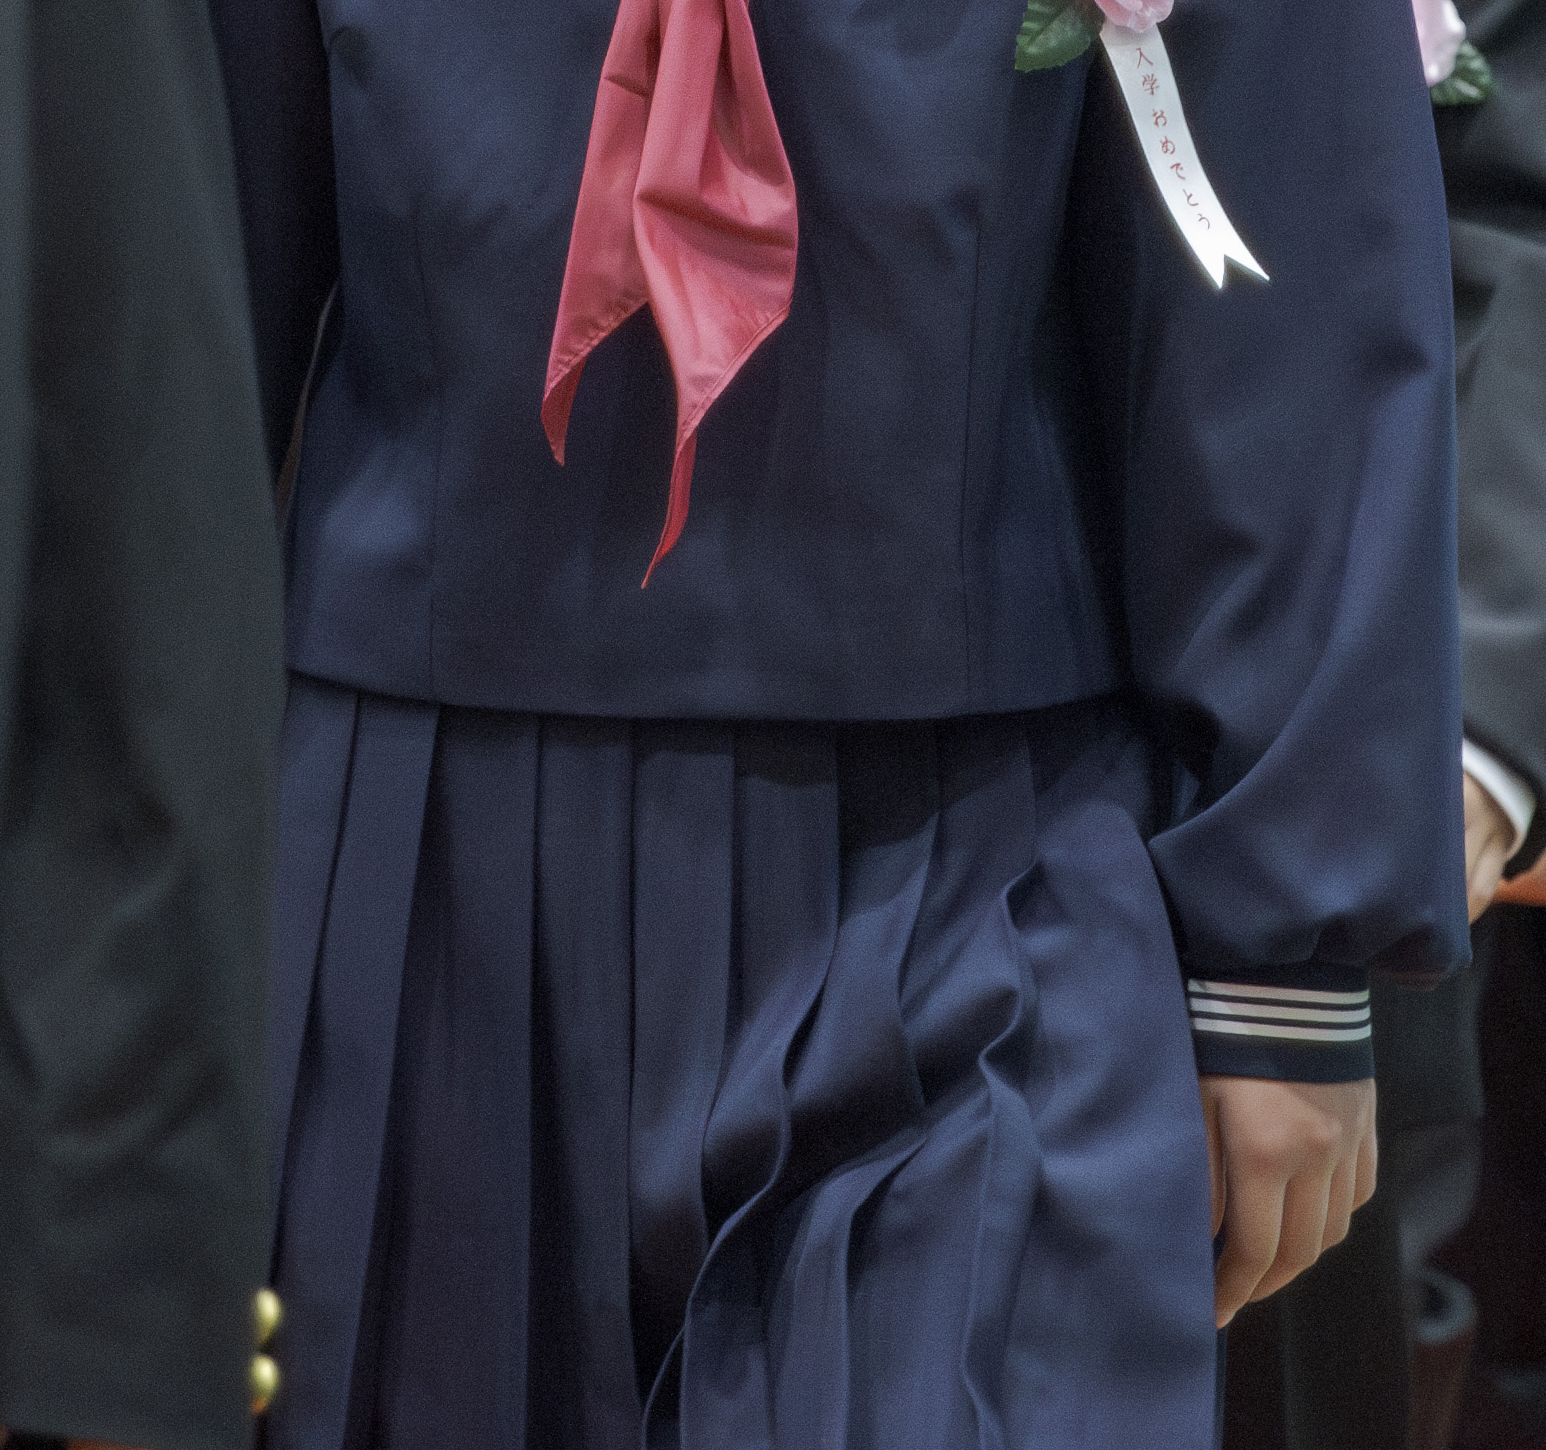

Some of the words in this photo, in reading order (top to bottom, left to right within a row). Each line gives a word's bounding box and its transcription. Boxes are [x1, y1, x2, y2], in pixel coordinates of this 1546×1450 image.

[1135, 46, 1212, 231] 入学おめでとう
